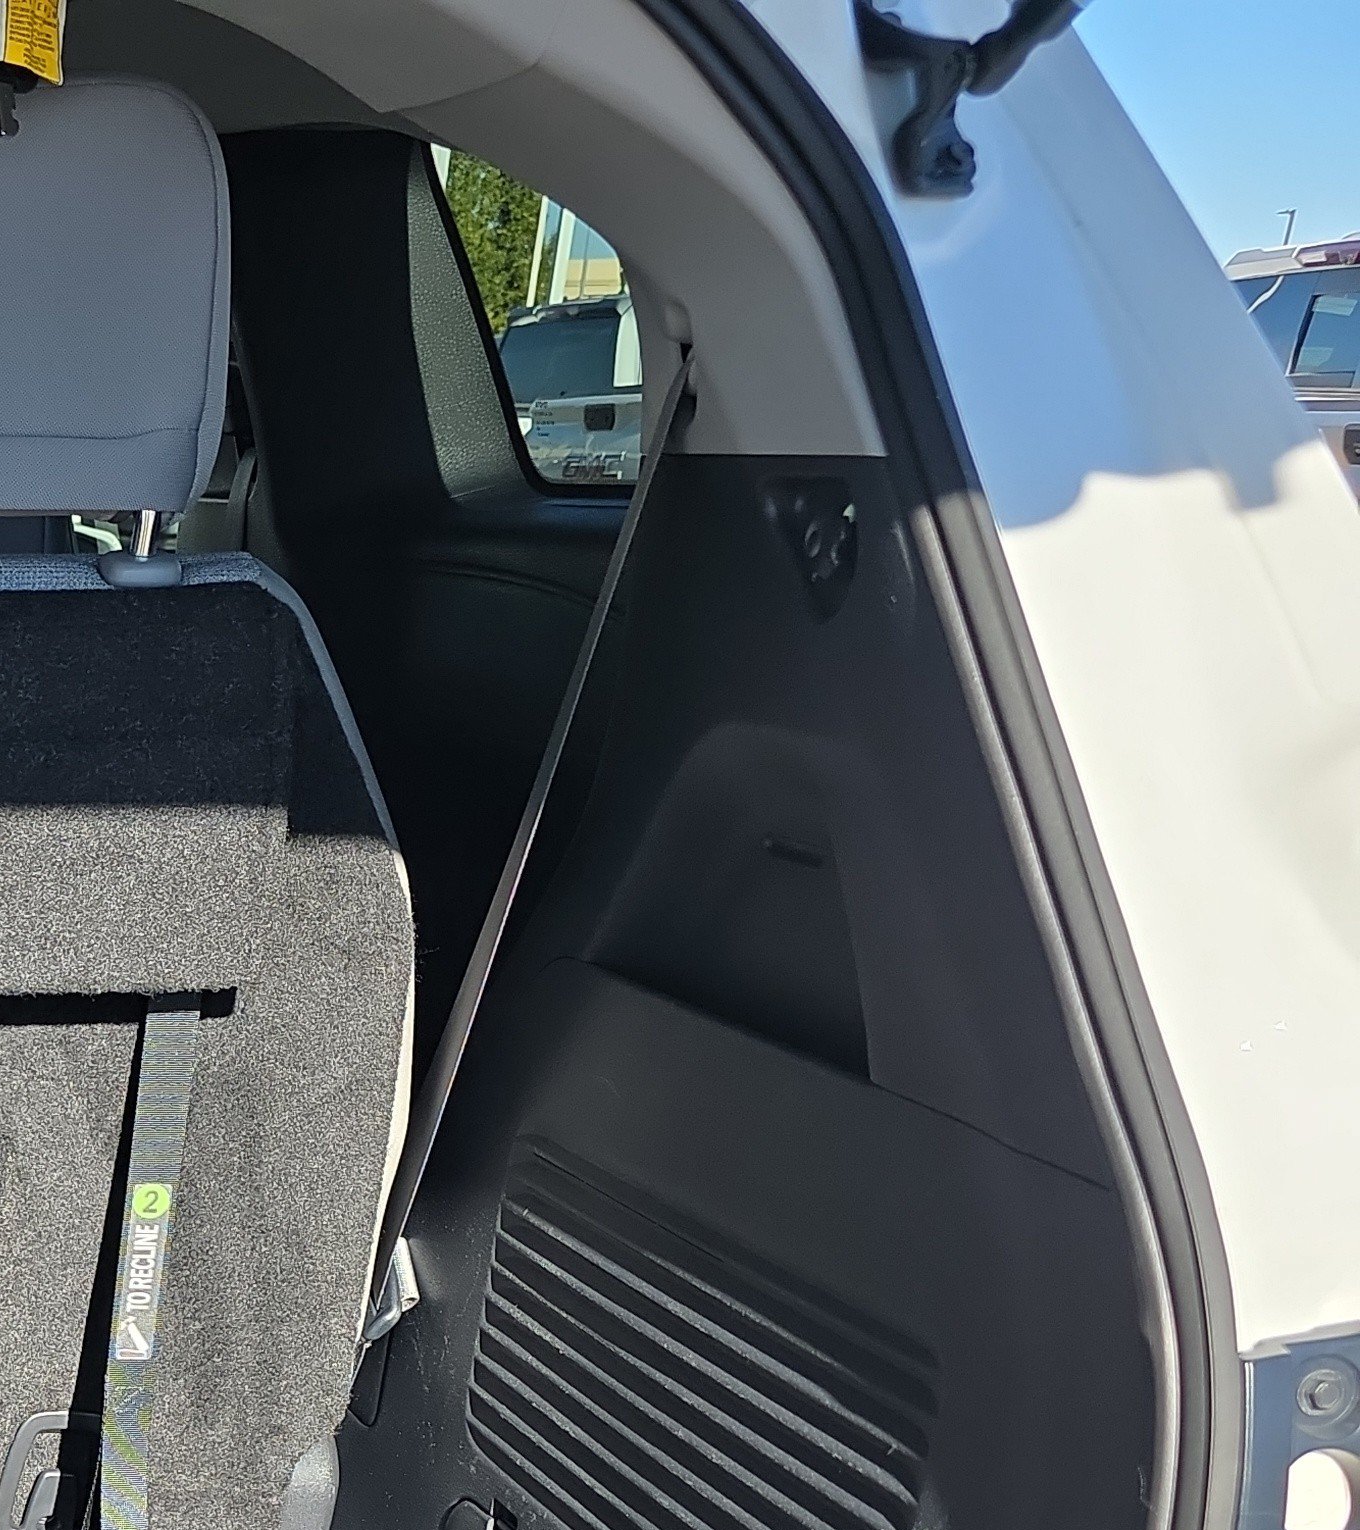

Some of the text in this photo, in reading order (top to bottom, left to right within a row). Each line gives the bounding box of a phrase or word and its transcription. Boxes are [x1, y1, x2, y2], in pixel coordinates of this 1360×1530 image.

[143, 1190, 159, 1213] 2
[127, 1224, 160, 1312] TO RECLINE
